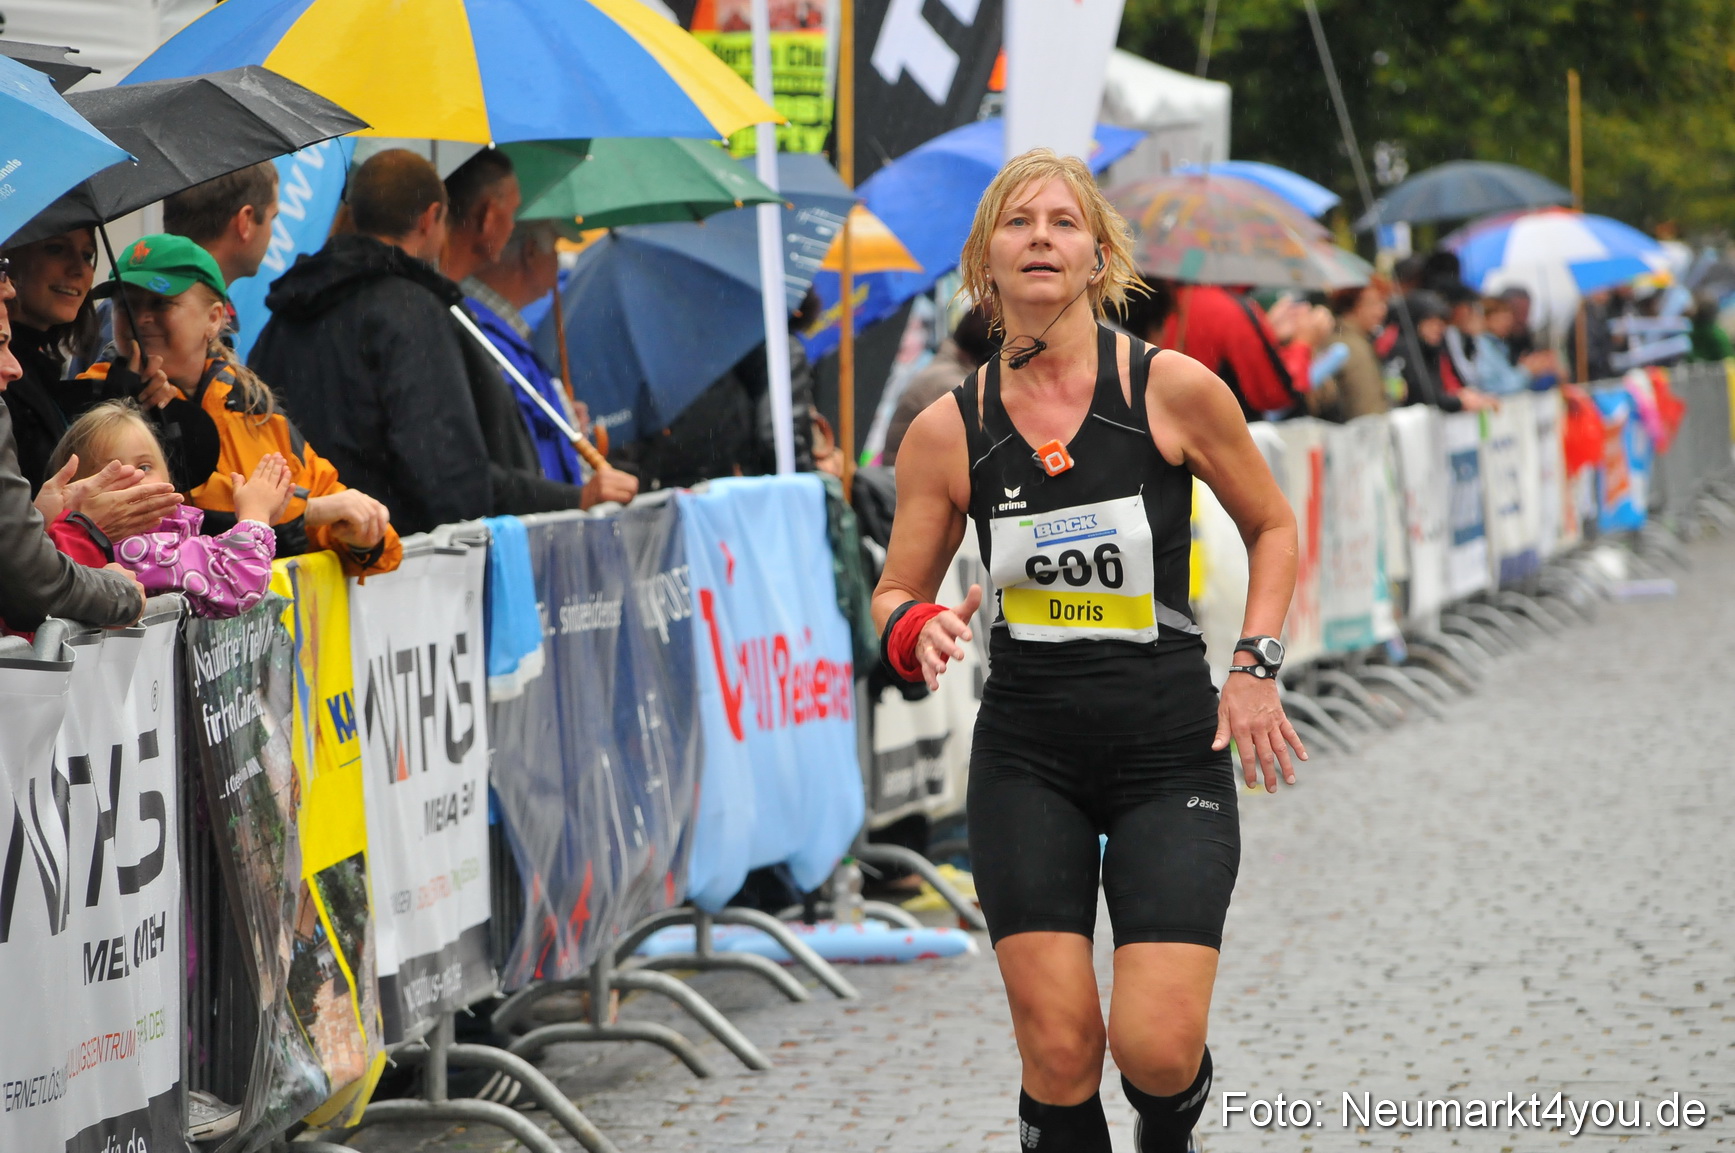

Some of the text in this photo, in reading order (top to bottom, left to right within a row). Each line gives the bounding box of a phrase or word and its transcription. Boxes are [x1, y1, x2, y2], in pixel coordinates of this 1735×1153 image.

[999, 501, 1027, 511] erima
[1034, 514, 1097, 538] BOCK
[1050, 599, 1104, 621] Doris
[1199, 799, 1220, 811] asics
